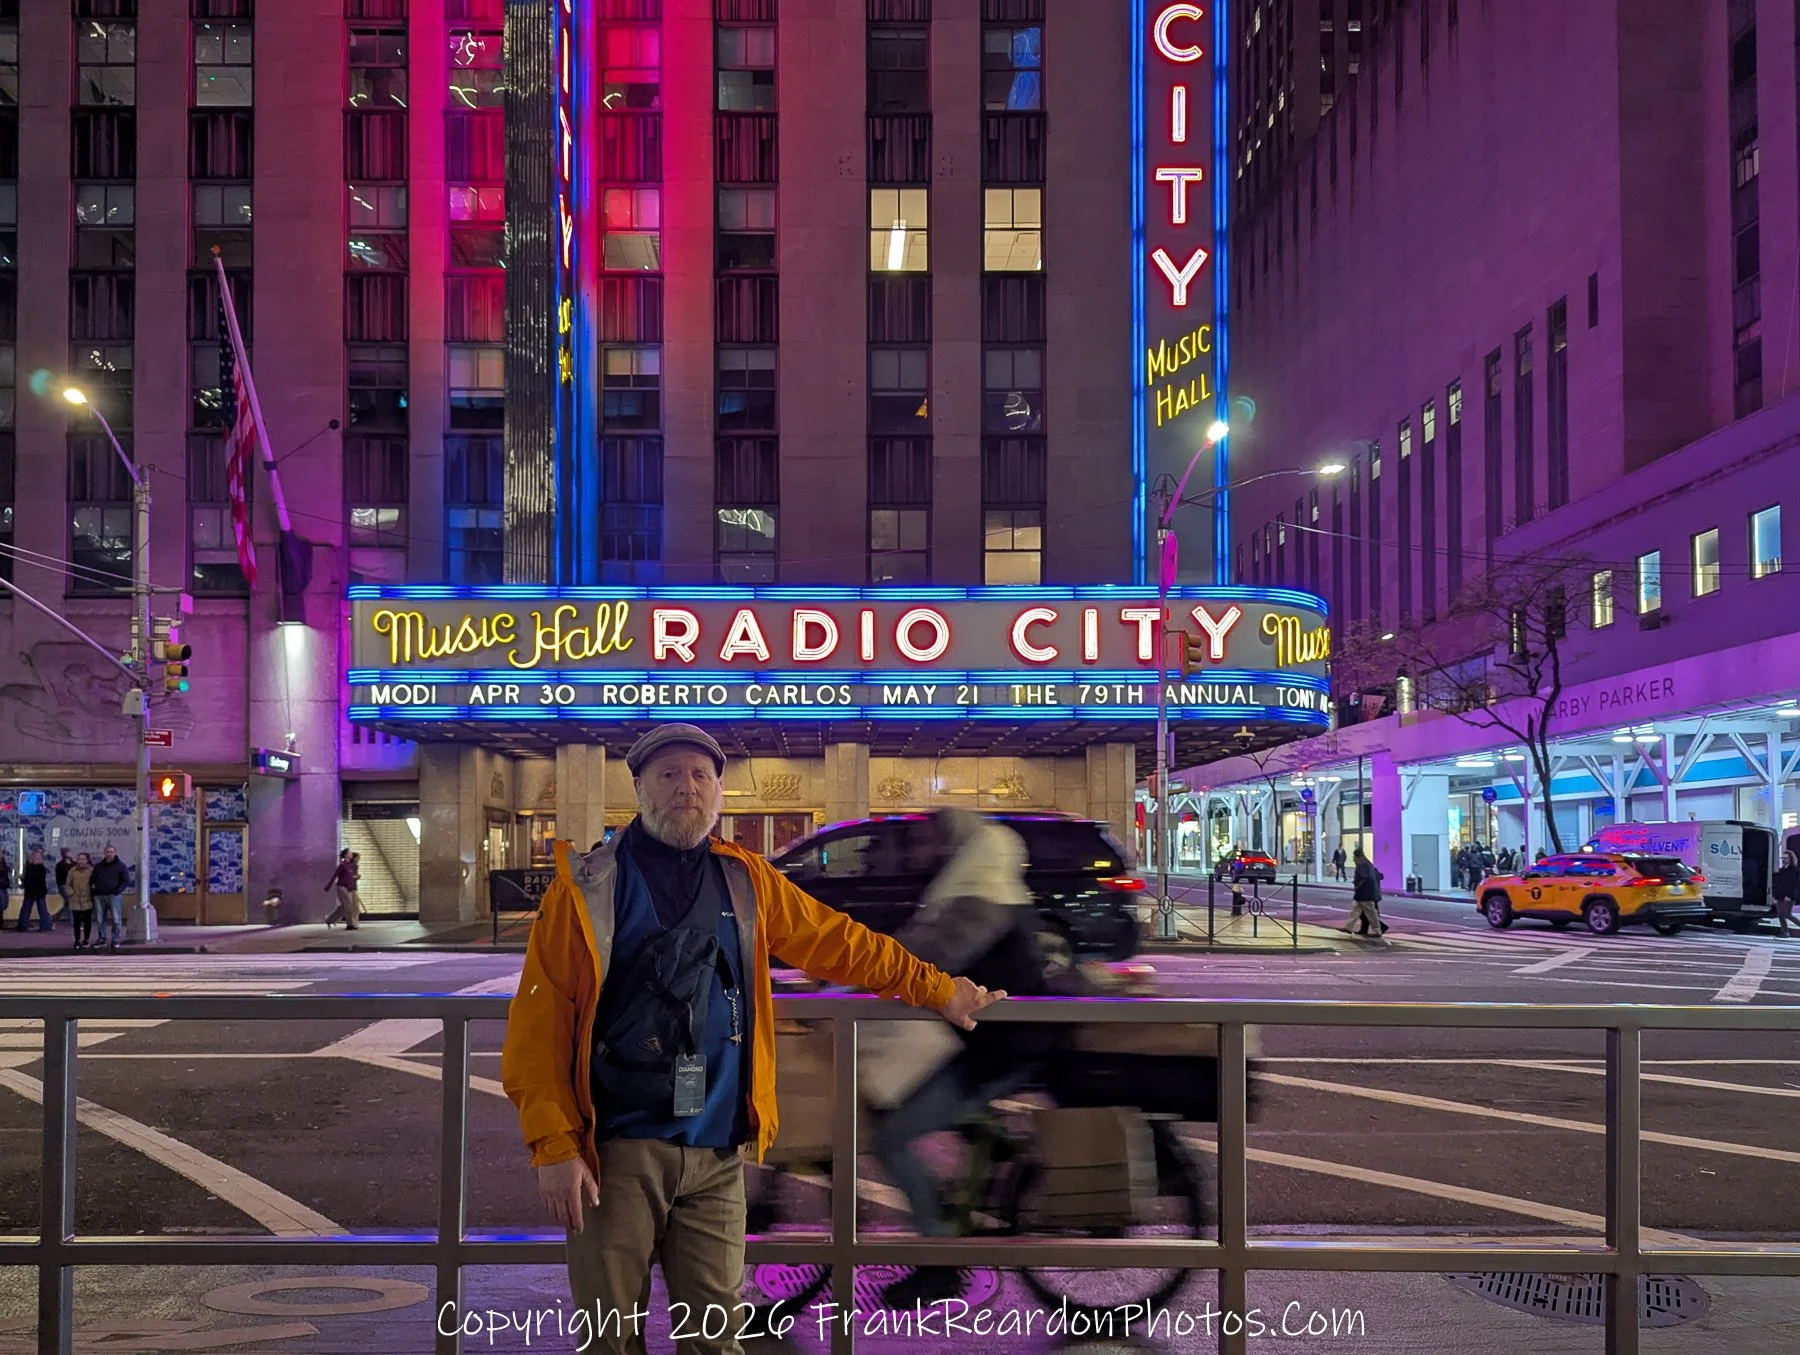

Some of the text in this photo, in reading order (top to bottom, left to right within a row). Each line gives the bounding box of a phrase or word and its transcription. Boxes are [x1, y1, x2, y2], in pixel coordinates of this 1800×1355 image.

[1152, 3, 1208, 306] CITY
[372, 608, 516, 665] Music
[508, 600, 633, 669] Hall
[652, 607, 952, 664] RADIO
[1012, 605, 1242, 661] CITY
[370, 684, 437, 705] MODI
[468, 684, 520, 705] APR
[539, 684, 576, 705] 30
[603, 684, 728, 705] ROBERTO
[745, 683, 852, 705] CARLOS
[883, 684, 938, 705] MAY
[956, 684, 979, 705] 21
[1011, 683, 1058, 706] THE
[1078, 684, 1143, 705] 79TH
[1165, 684, 1260, 705] ANNUAL
[1275, 686, 1316, 710] TONY
[1599, 677, 1675, 710] PARKER
[64, 827, 131, 837] COMING SOON
[678, 1065, 704, 1073] DIAMOND
